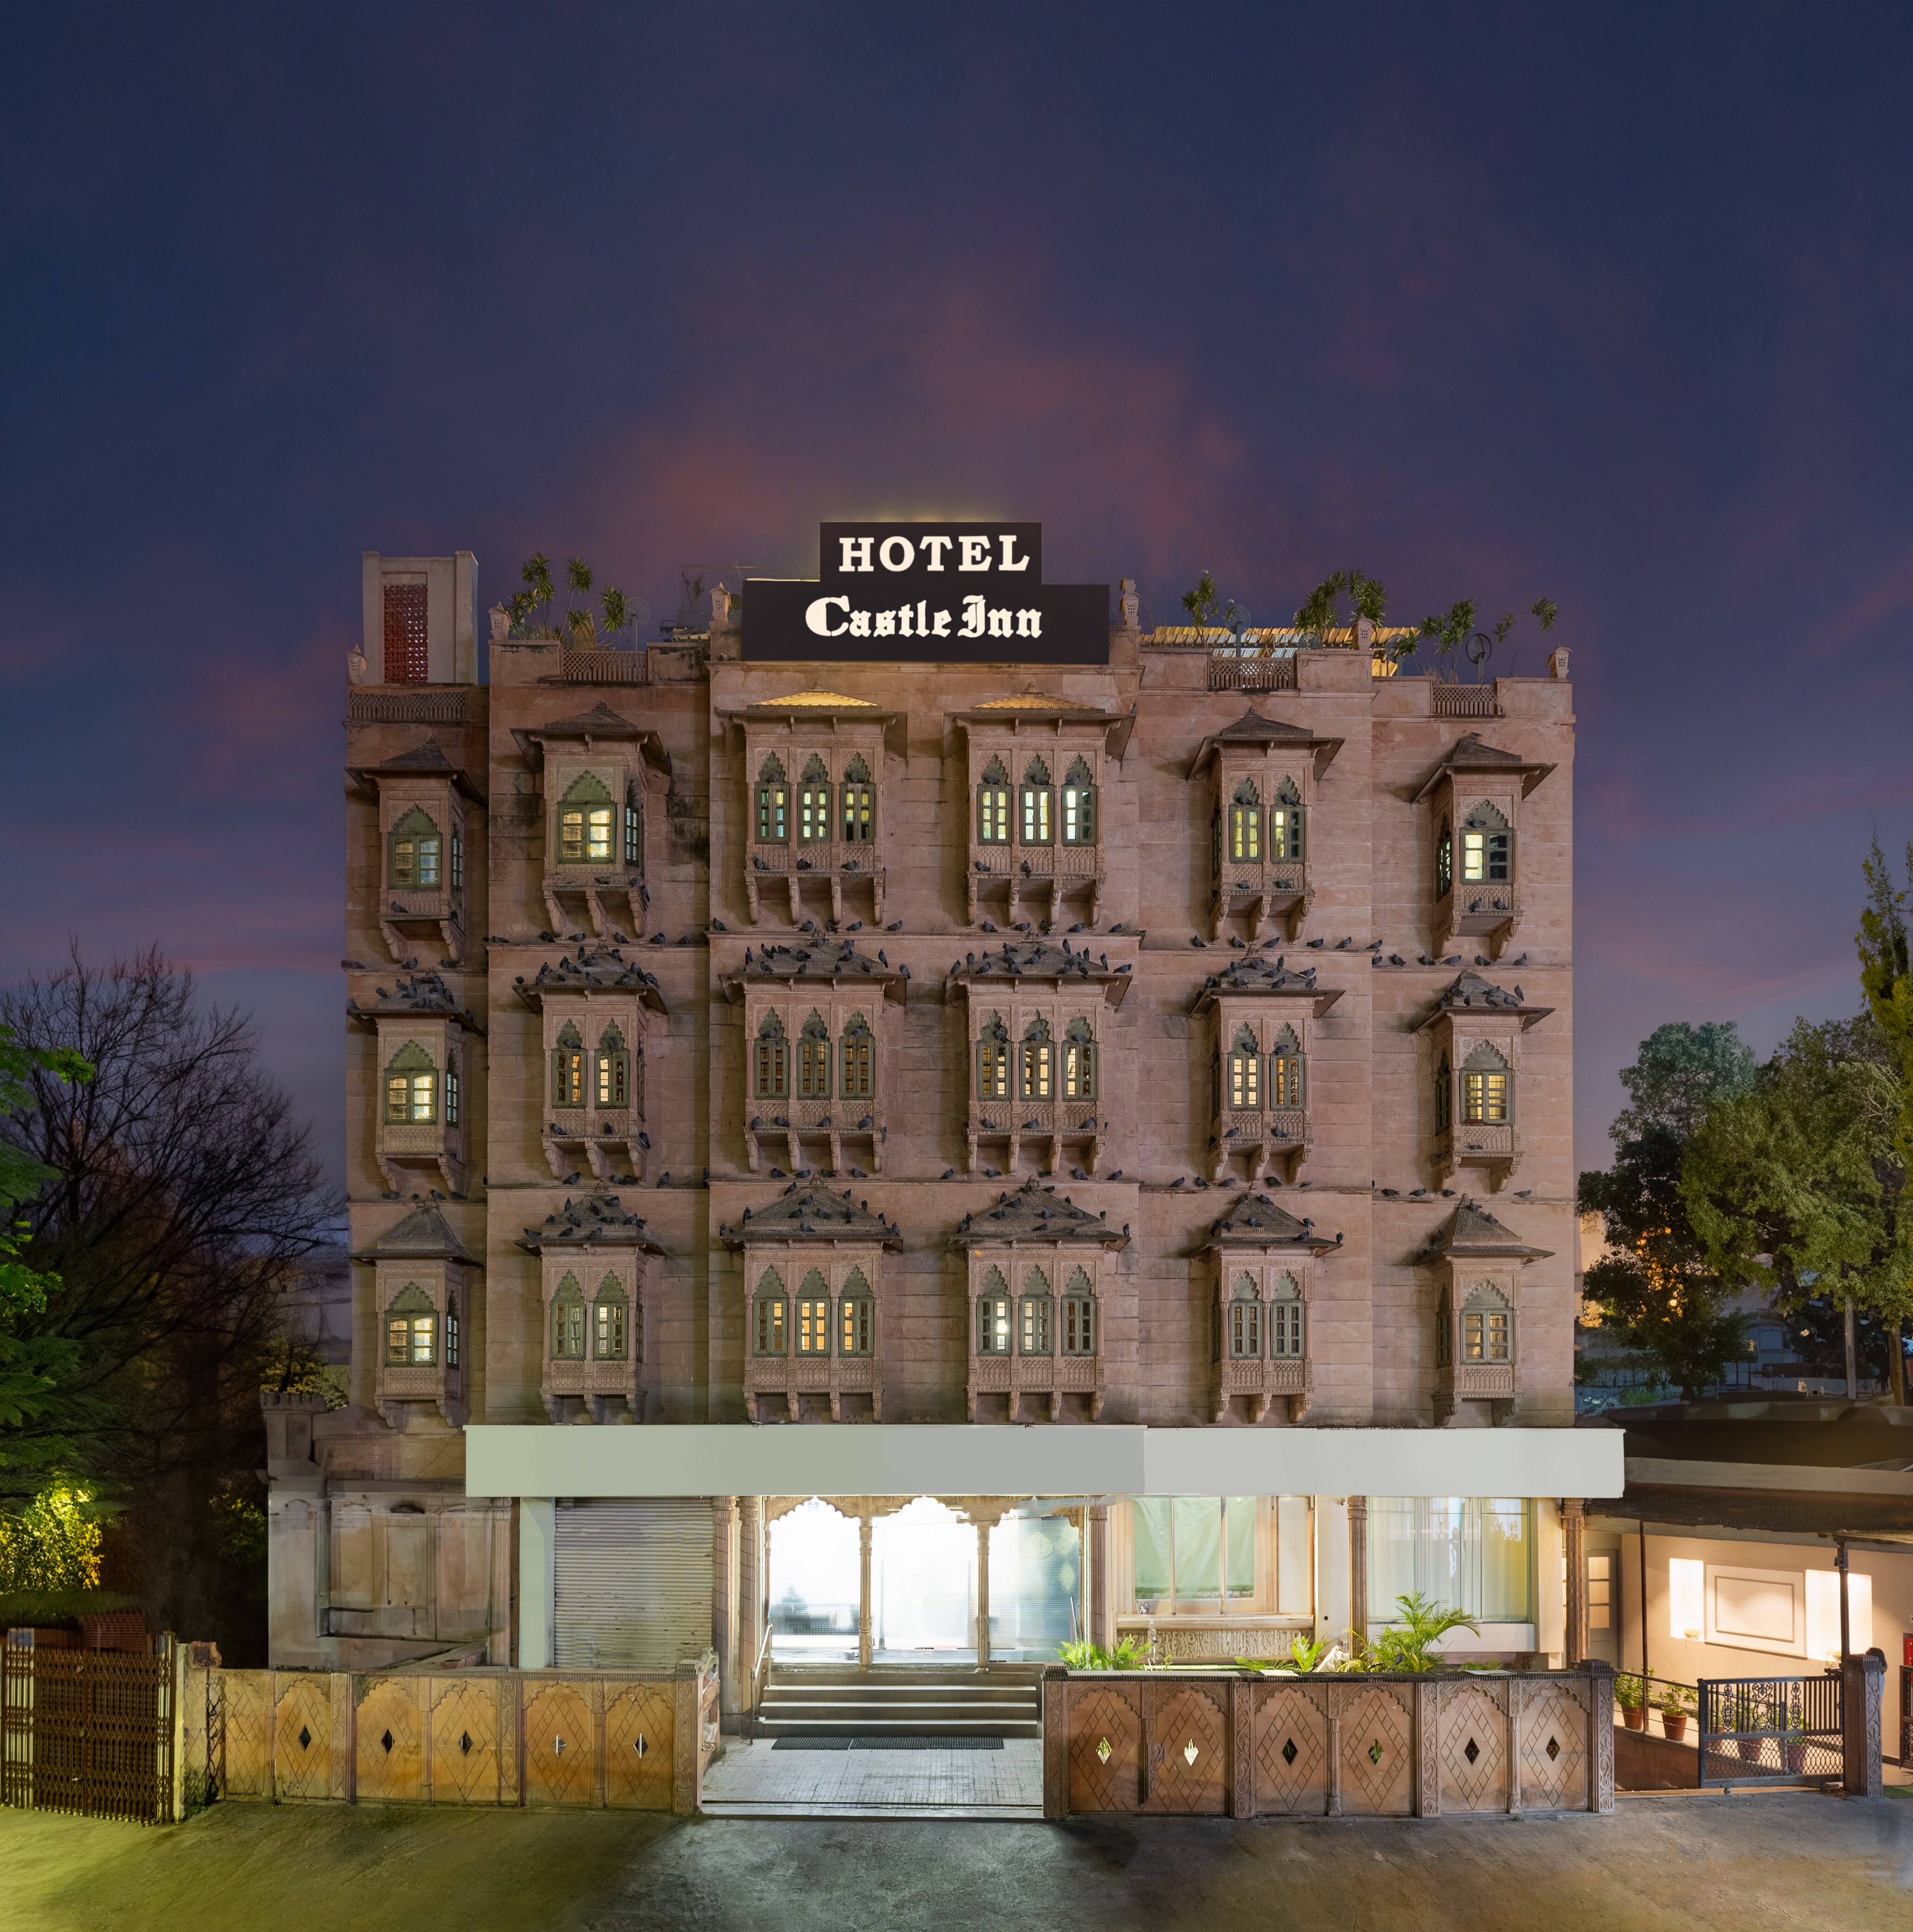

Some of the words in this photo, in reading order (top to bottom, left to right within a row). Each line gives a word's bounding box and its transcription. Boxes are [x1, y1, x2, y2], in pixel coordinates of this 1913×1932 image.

[839, 535, 1030, 572] HOTEL
[805, 595, 952, 638] Castle
[957, 595, 1042, 638] Inn
